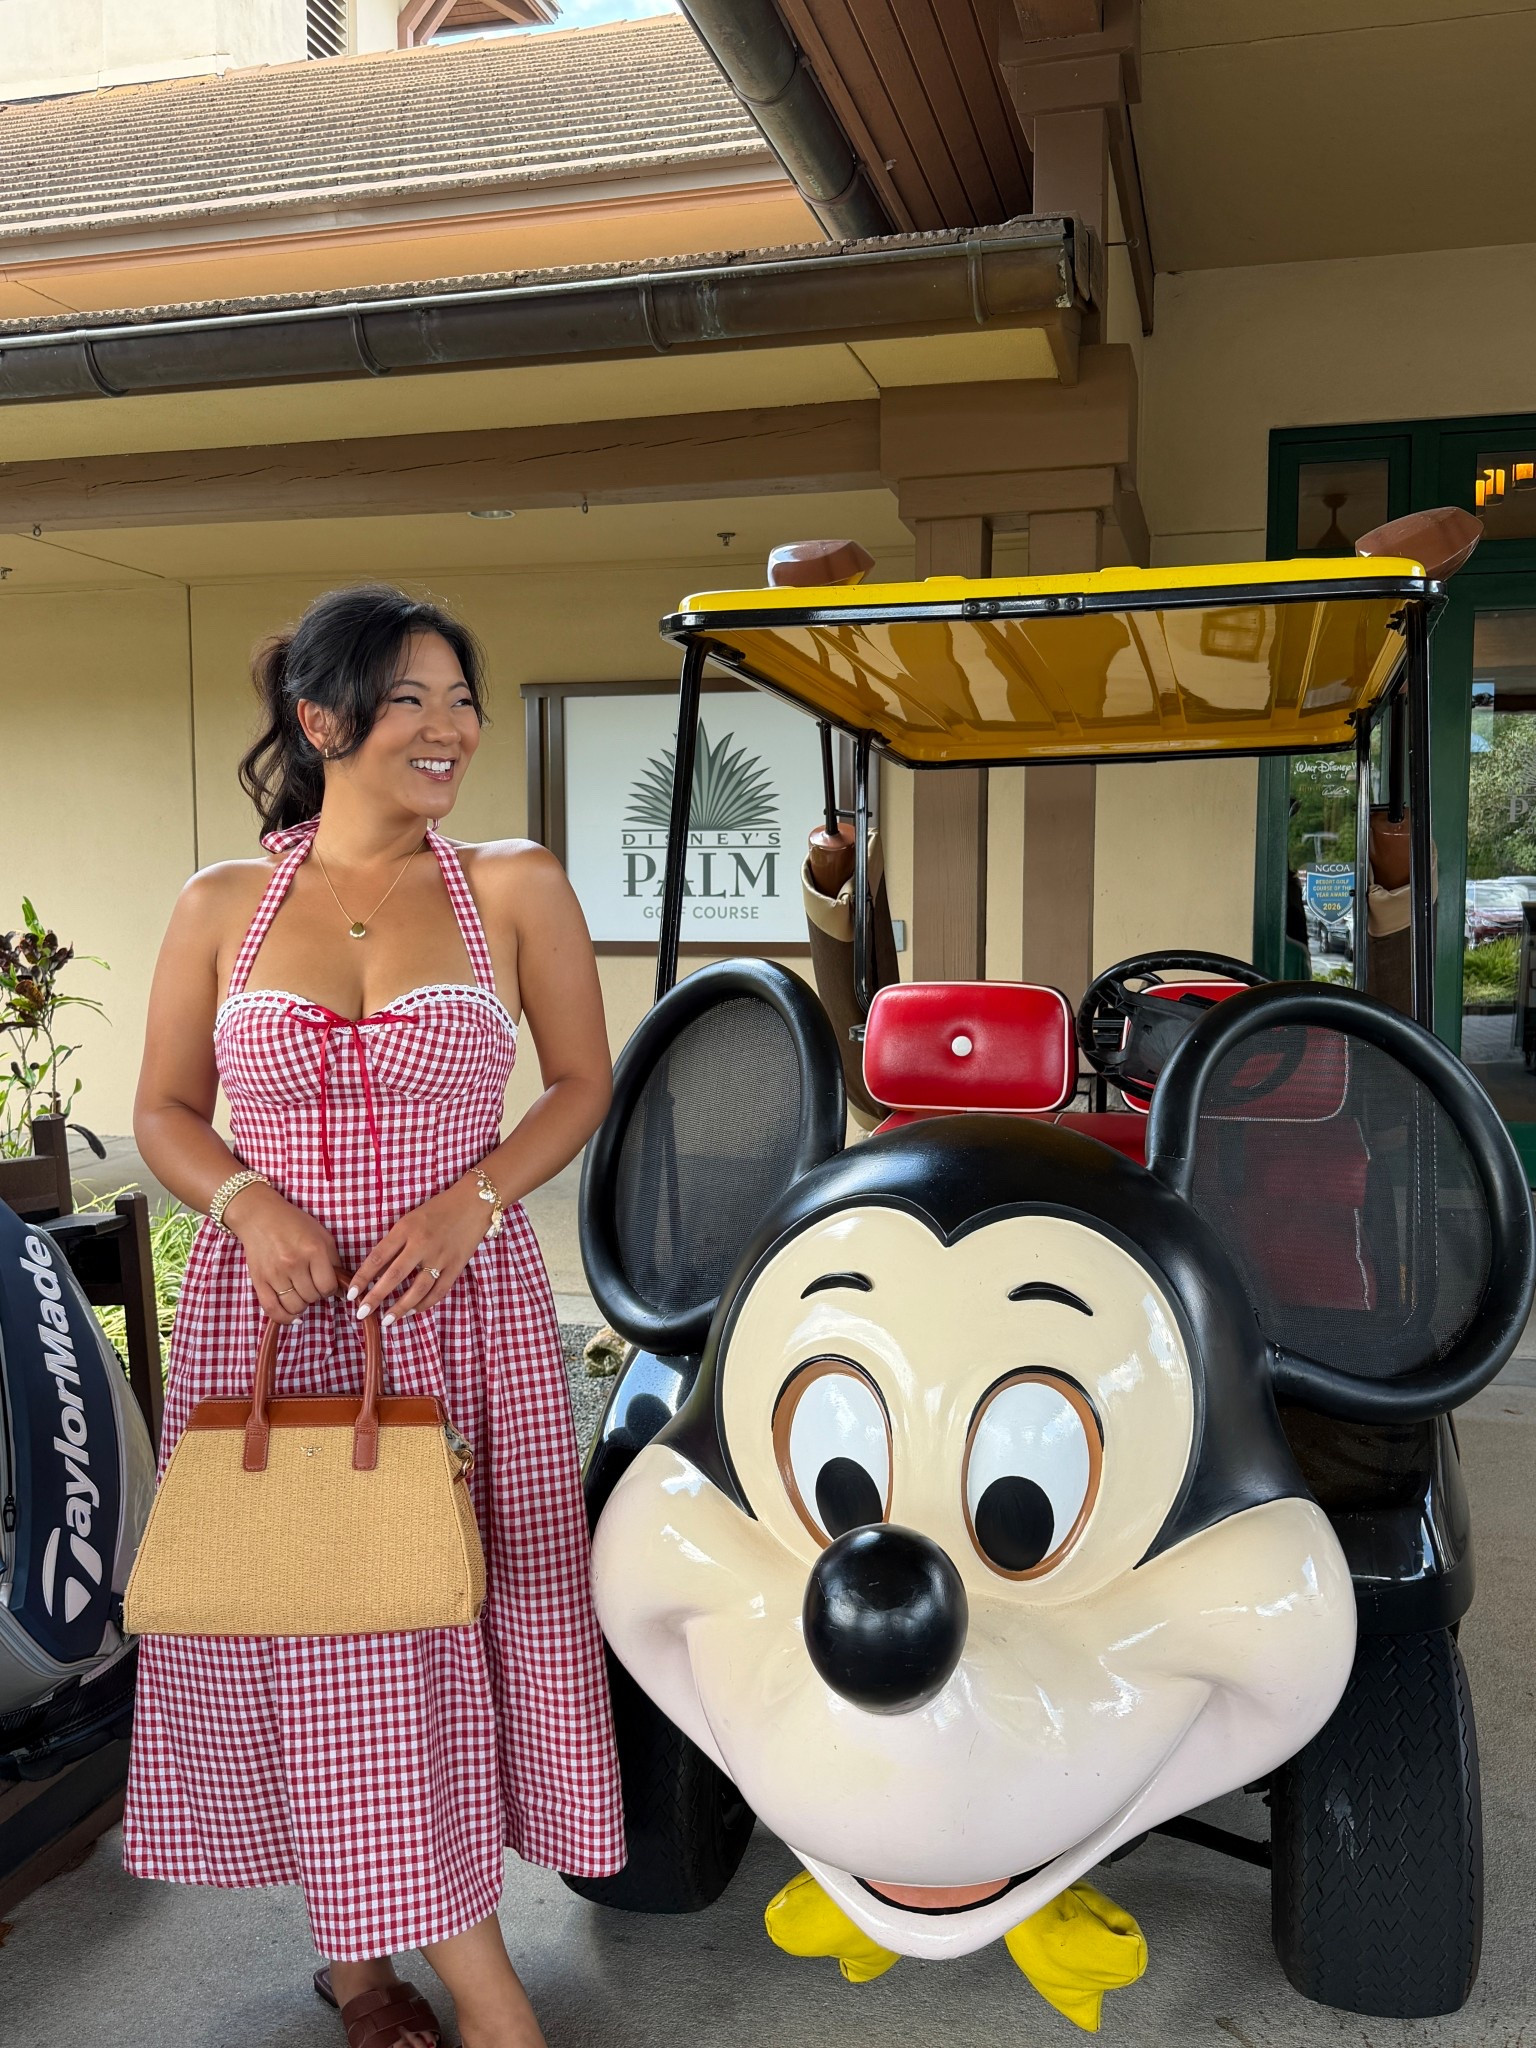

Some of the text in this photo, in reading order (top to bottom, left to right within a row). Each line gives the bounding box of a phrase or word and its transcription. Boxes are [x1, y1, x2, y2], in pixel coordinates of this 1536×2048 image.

[622, 832, 781, 846] DINEY'S
[1315, 864, 1351, 873] NGCOA
[692, 906, 760, 919] COURSE
[1322, 902, 1341, 911] 2026
[19, 1234, 103, 1624] TaylorMade
